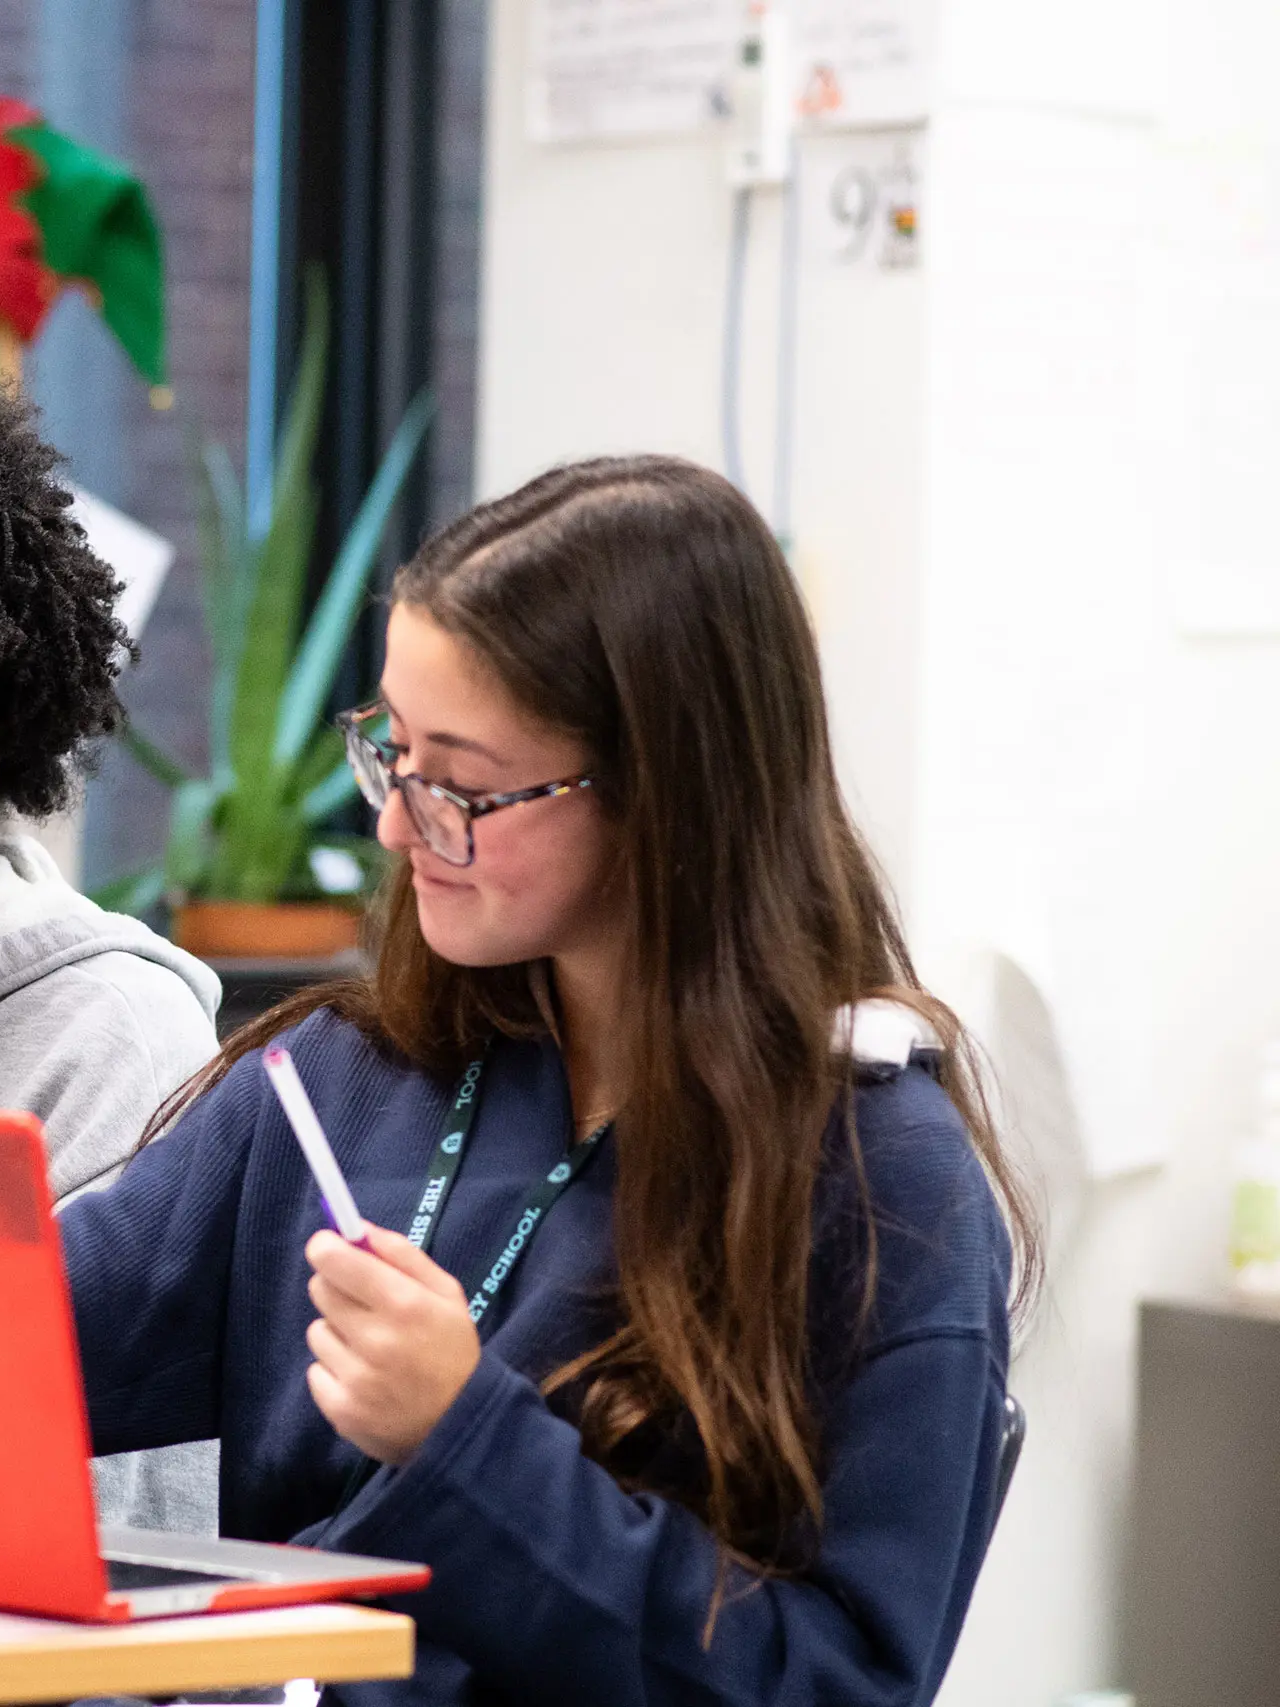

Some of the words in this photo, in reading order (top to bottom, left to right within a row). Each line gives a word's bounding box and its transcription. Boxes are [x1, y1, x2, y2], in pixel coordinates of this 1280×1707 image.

[417, 1175, 447, 1213] THE
[467, 1291, 489, 1323] EY
[482, 1206, 542, 1294] SCHOOL
